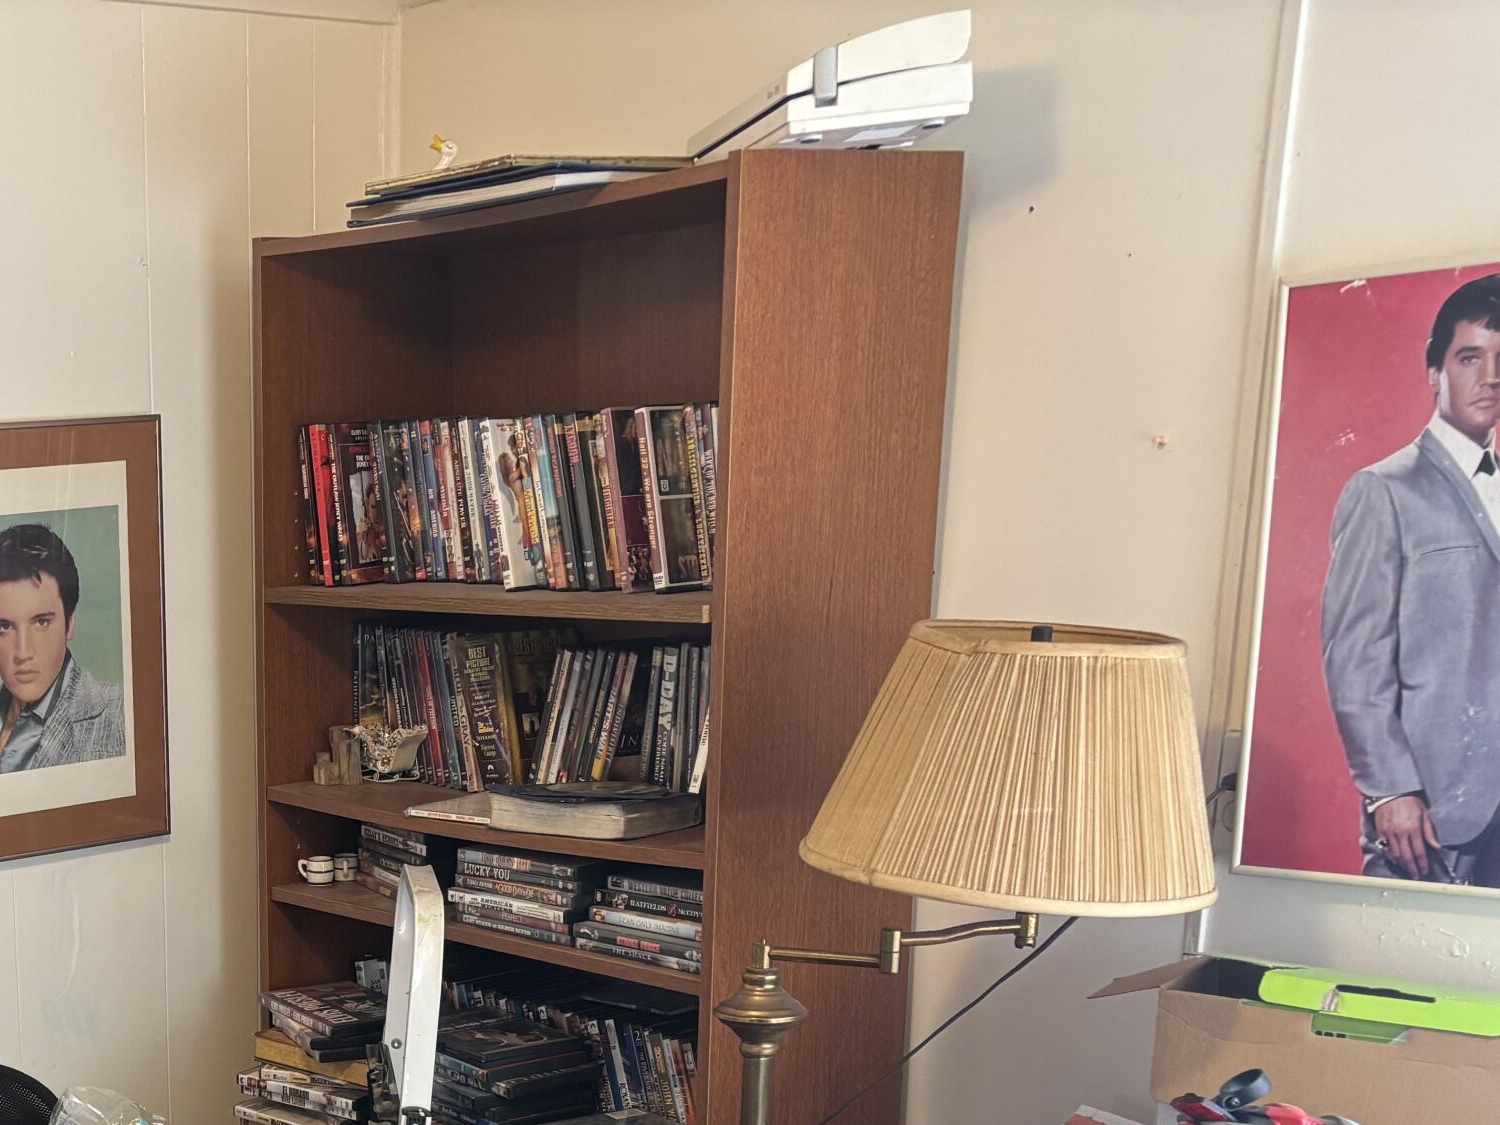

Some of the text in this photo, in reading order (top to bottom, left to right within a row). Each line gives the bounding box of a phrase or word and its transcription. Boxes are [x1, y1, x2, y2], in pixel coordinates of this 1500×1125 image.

[565, 423, 579, 464] TYCOON
[640, 457, 648, 469] 32
[452, 460, 467, 528] ABSOLUTE POWER
[643, 477, 651, 491] We
[430, 510, 438, 537] AMERICA
[646, 511, 658, 550] Stronger
[695, 518, 705, 545] LUCKY
[698, 547, 708, 577] TEXAN
[466, 658, 490, 667] PICTURE
[468, 647, 486, 658] BEST
[658, 654, 677, 730] D-DAY
[450, 695, 459, 726] UNITED
[460, 715, 470, 746] GRAY
[464, 863, 510, 881] LUCKY YOU
[480, 898, 513, 908] AMERICAN
[630, 900, 667, 912] HATFIELDS
[636, 920, 652, 929] ONLY
[612, 947, 652, 960] THE SHACK
[659, 1078, 674, 1106] JOHN
